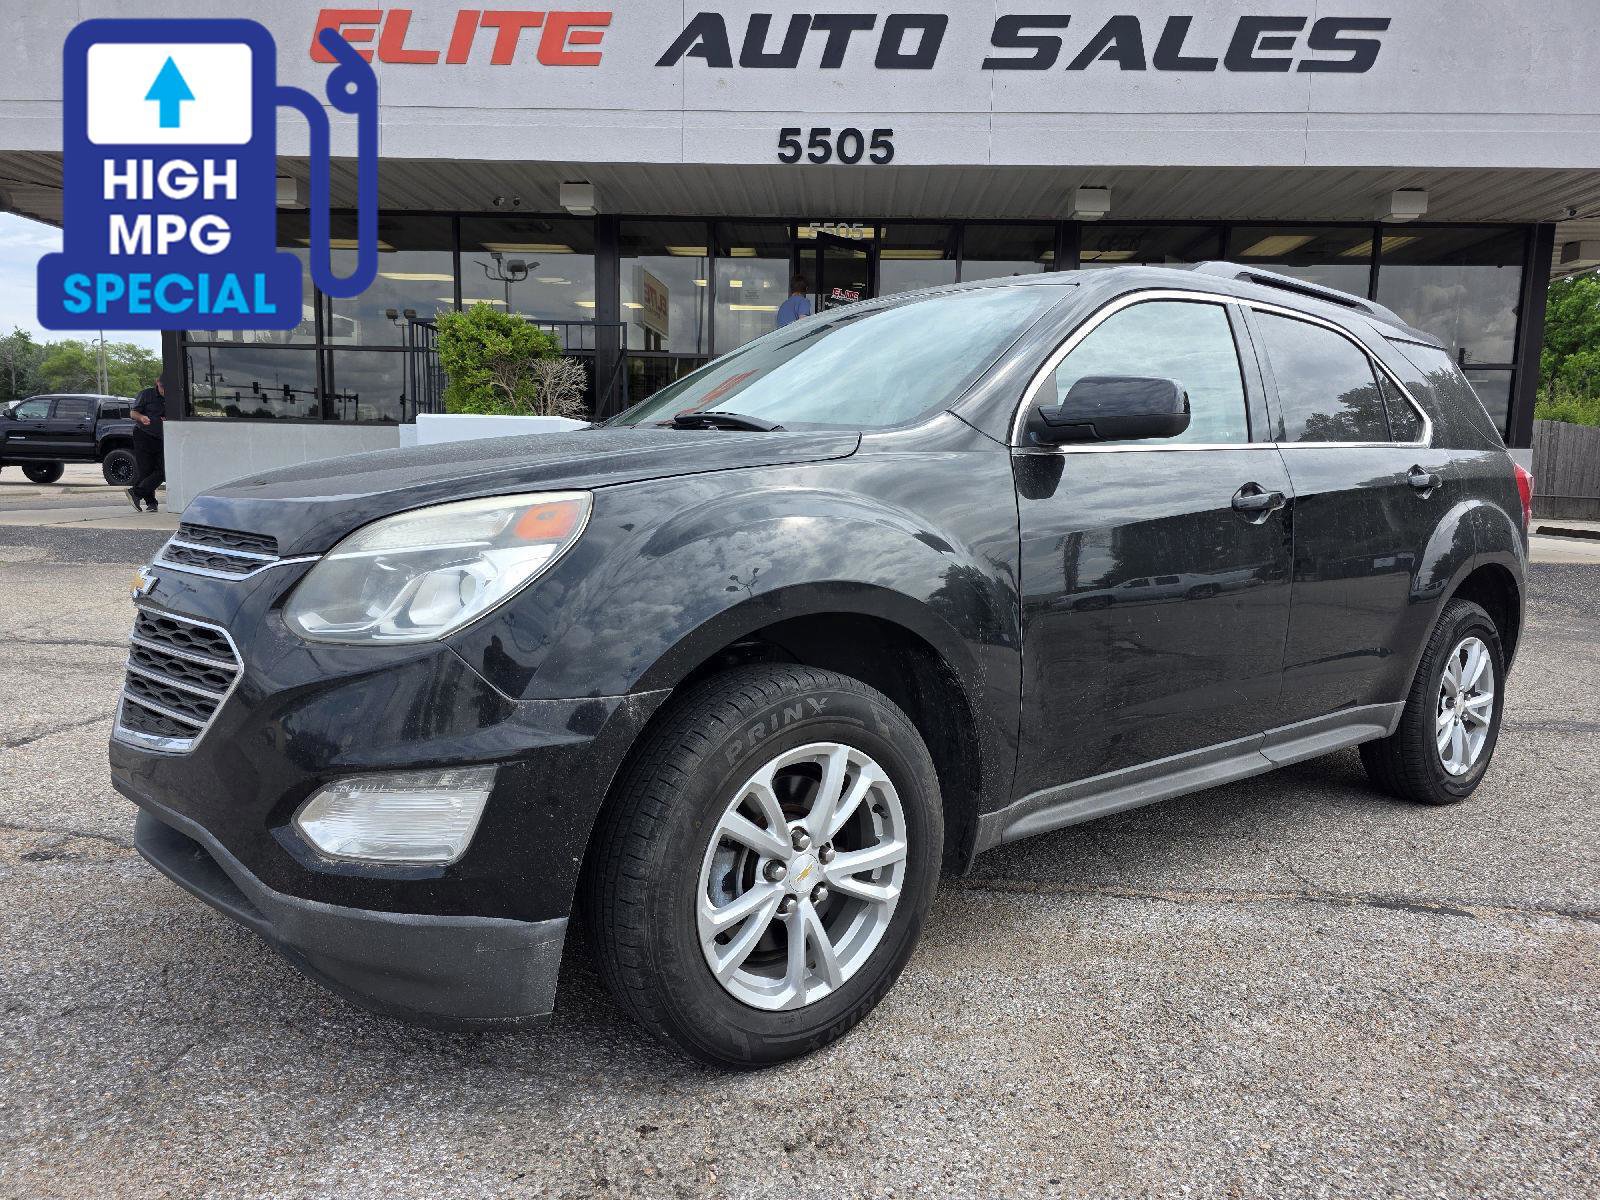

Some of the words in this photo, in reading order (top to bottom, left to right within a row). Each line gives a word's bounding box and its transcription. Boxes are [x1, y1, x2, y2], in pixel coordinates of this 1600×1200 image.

[309, 9, 612, 66] ELITE
[655, 12, 949, 69] AUTO
[982, 14, 1391, 73] SALES
[777, 127, 895, 165] 5505
[807, 222, 864, 241] 5505
